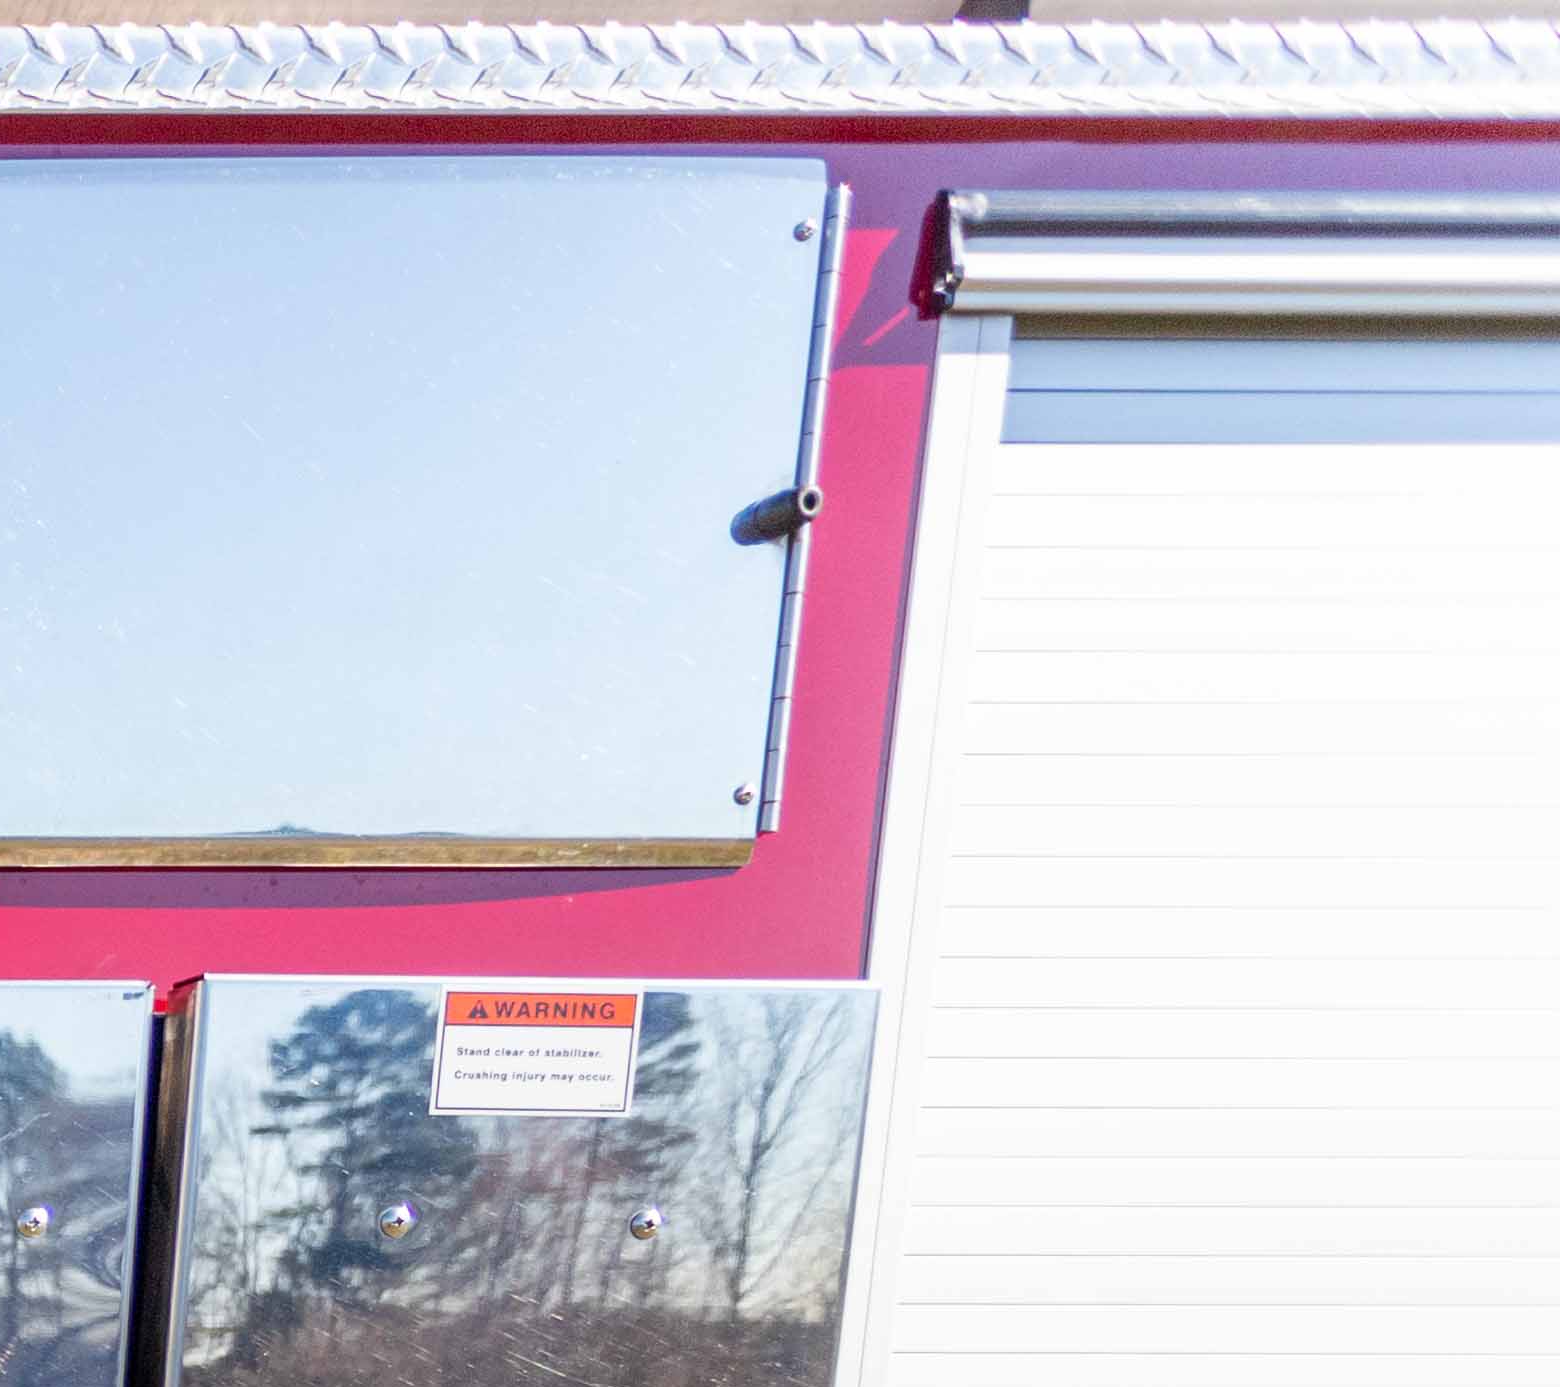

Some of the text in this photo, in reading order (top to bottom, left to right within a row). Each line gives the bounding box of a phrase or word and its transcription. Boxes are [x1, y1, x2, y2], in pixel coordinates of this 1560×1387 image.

[495, 1001, 616, 1020] WARNING
[456, 1047, 602, 1058] Stand clear of stabilizer.
[454, 1070, 508, 1082] Crushing
[511, 1071, 546, 1082] injury
[551, 1073, 573, 1083] may
